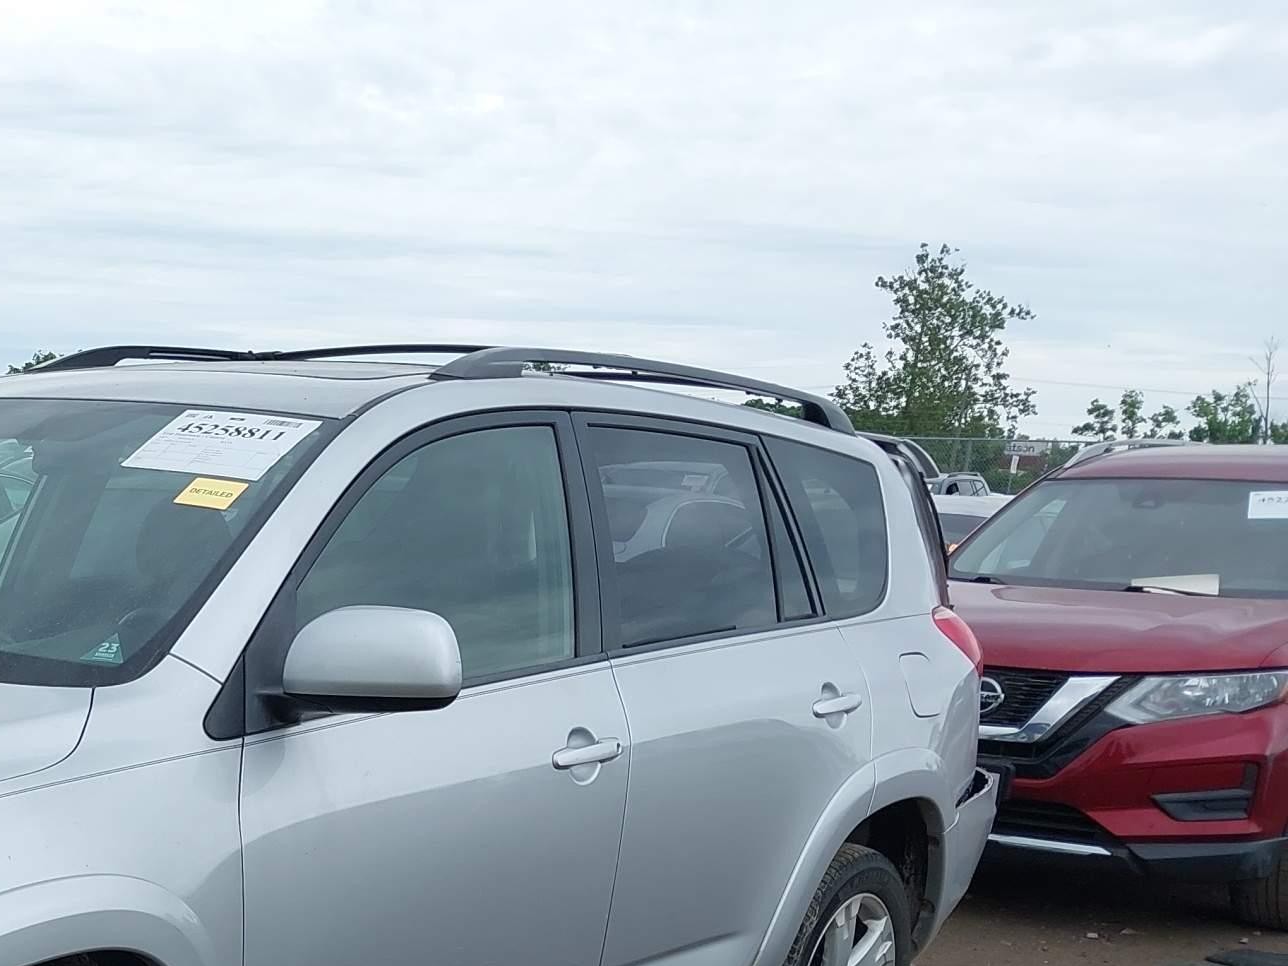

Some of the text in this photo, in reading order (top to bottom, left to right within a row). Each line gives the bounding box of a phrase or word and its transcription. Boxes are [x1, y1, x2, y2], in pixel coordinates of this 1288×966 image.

[177, 423, 285, 441] 45258811
[189, 487, 234, 499] DETAILED
[98, 642, 120, 653] 23
